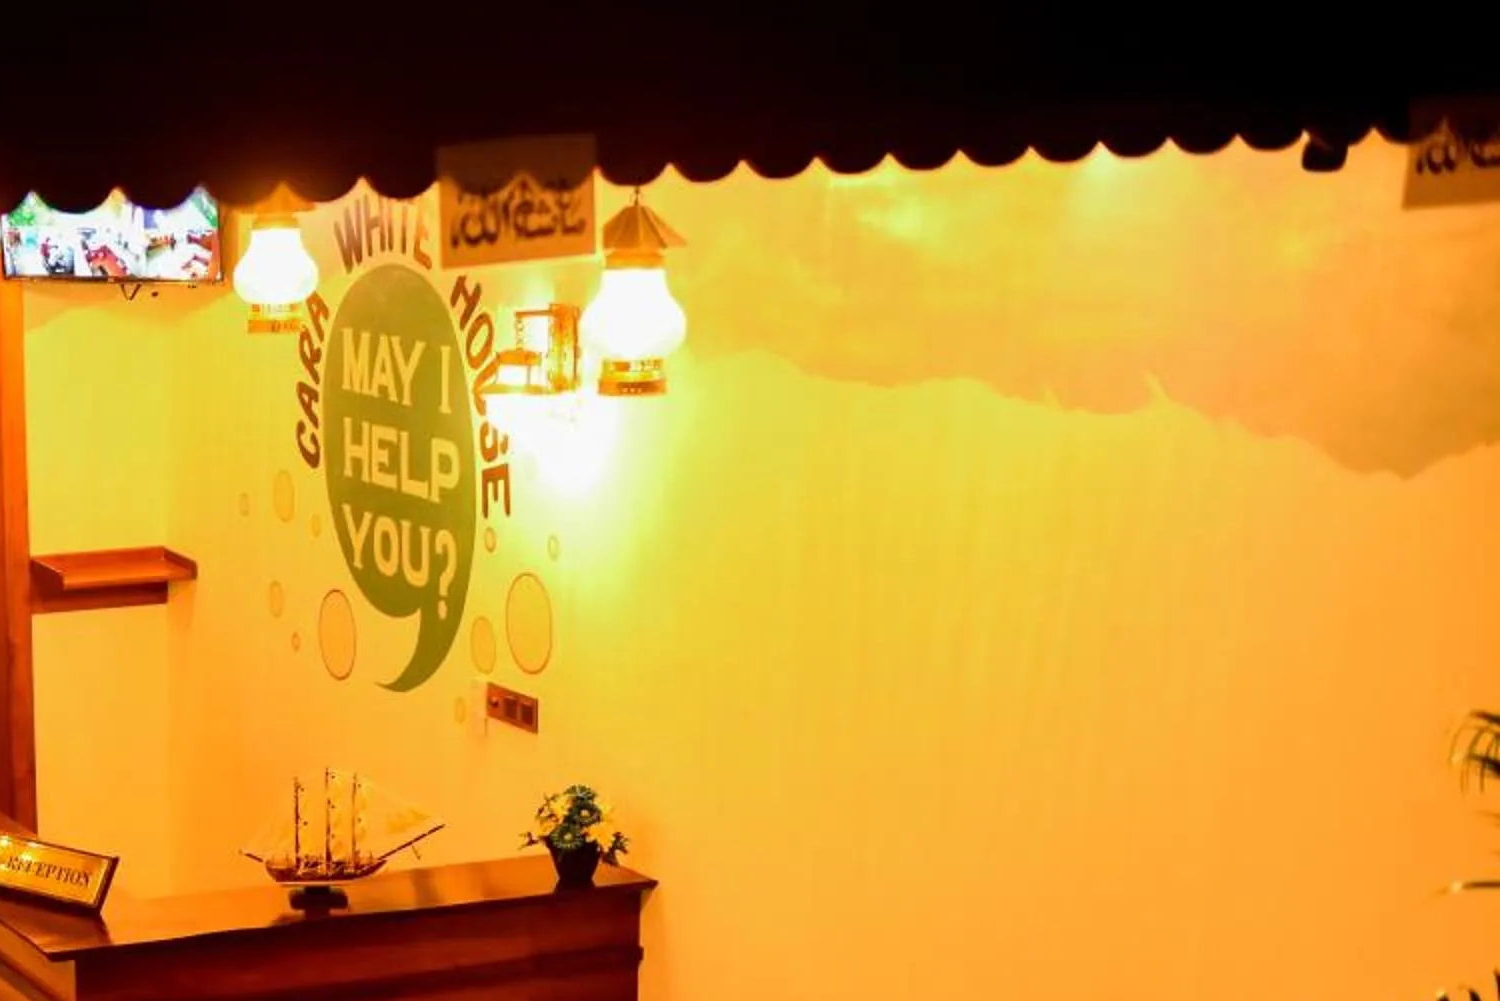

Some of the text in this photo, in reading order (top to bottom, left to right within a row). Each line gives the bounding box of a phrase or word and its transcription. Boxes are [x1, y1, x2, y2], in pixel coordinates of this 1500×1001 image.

[334, 192, 432, 274] WHITE
[341, 328, 452, 414] MAY I
[343, 417, 461, 503] HELP
[341, 503, 457, 620] YOU?
[5, 855, 93, 888] RECEPTION
